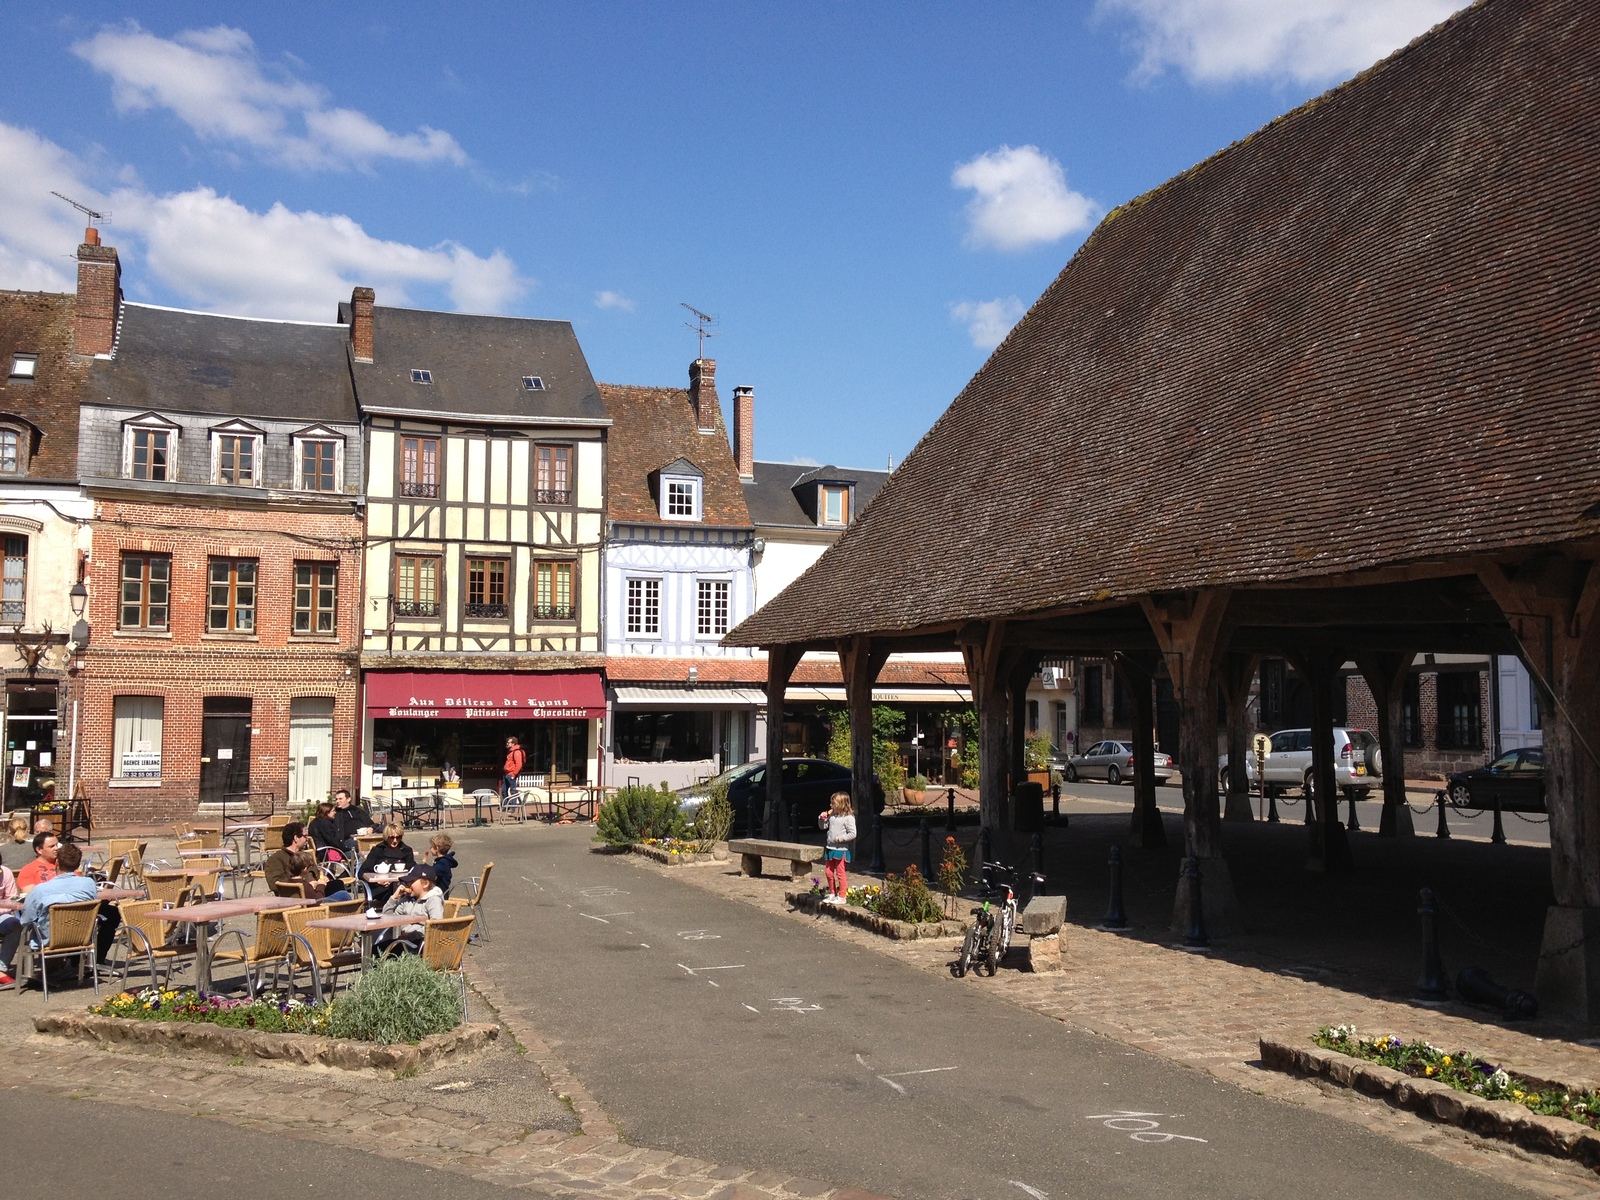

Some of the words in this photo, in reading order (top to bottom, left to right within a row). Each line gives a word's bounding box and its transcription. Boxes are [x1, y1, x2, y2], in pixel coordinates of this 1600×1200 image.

[408, 696, 435, 706] Aux
[444, 697, 494, 706] Délices
[503, 698, 518, 706] de
[527, 698, 569, 708] Lyons
[388, 707, 440, 718] Boulanger
[465, 708, 509, 719] Pâtissier
[533, 708, 587, 718] Chocolatier
[1084, 1109, 1209, 1143] 106
